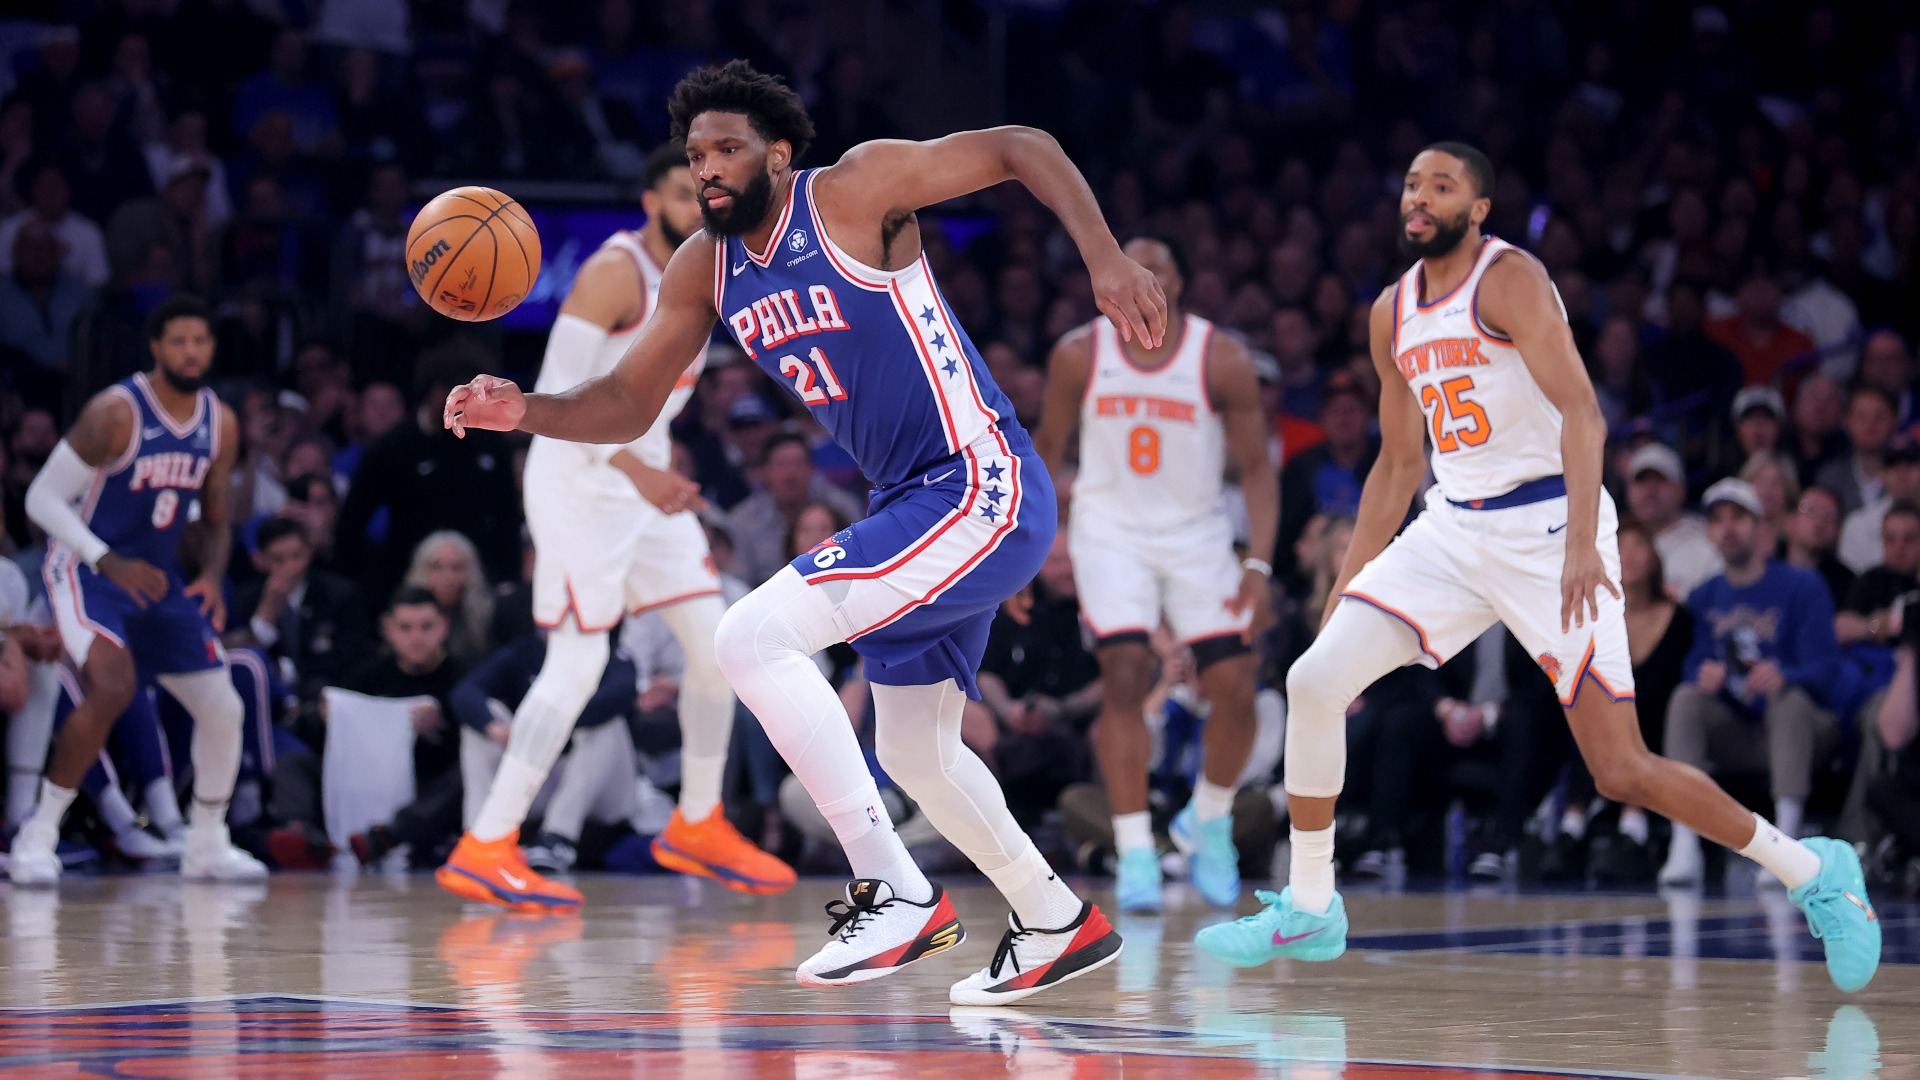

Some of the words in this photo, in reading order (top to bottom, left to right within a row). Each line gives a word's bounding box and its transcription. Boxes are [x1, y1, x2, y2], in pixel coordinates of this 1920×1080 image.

[787, 250, 818, 267] crypto.com
[728, 284, 851, 360] PHILA
[779, 346, 849, 405] 21
[1431, 337, 1490, 370] YORK
[1421, 375, 1492, 453] 25
[1129, 426, 1160, 475] 8
[152, 489, 179, 529] 8
